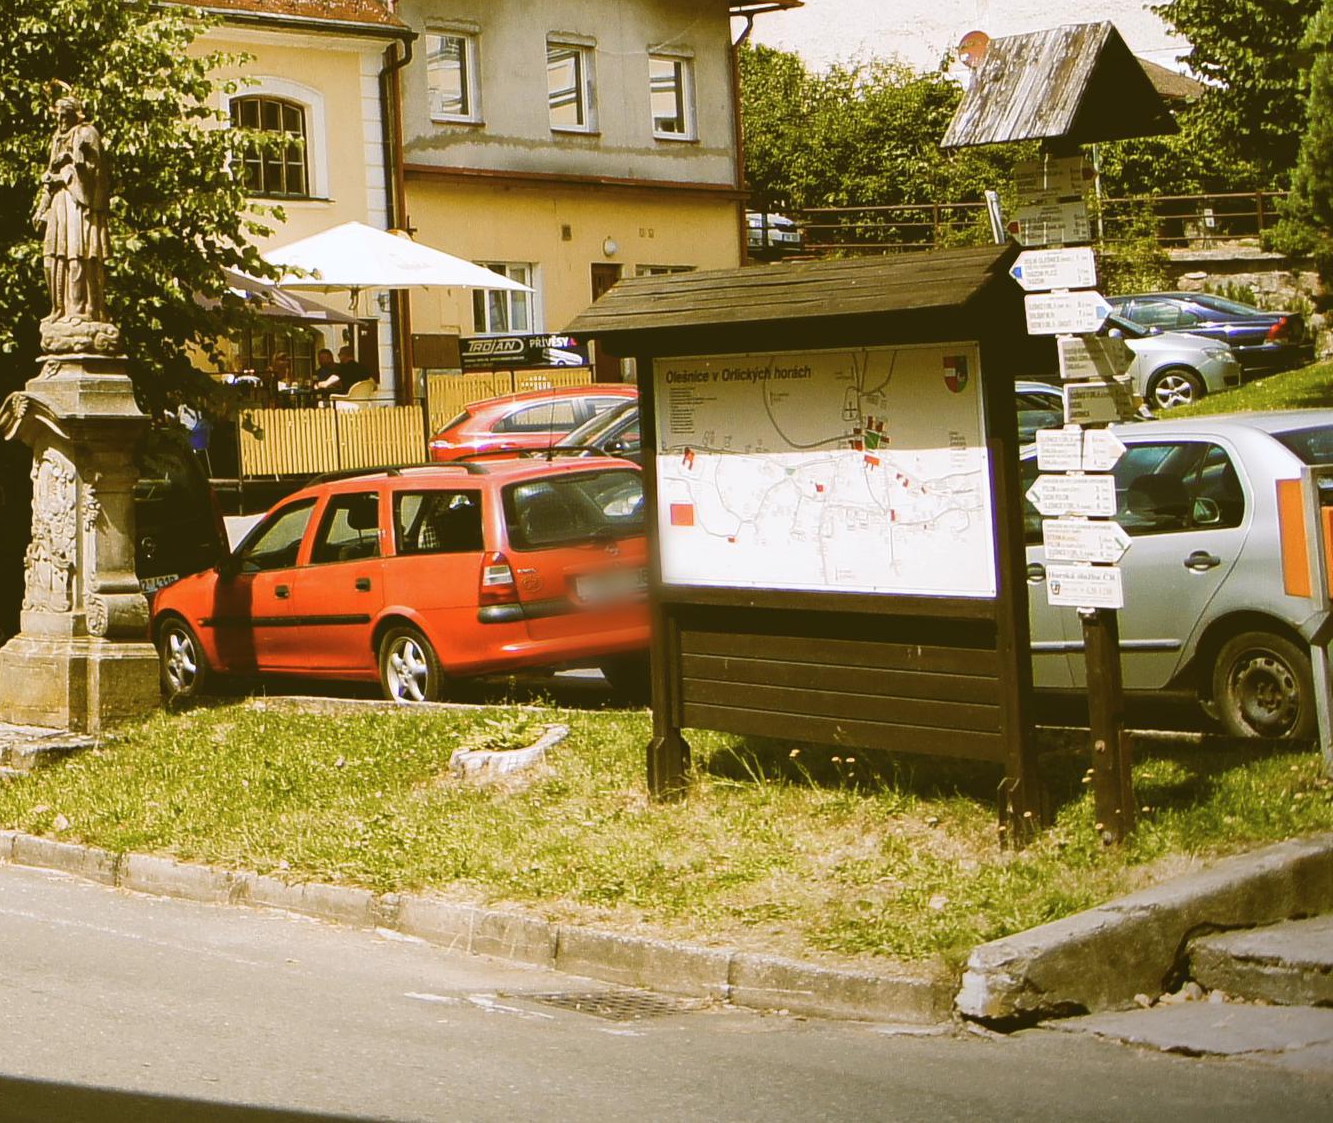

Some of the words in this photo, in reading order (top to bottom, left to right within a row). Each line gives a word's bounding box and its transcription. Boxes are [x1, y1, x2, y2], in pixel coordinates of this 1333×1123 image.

[468, 339, 516, 353] TROJAN
[529, 336, 569, 348] PŘÍVĚSY
[666, 369, 709, 383] Olešnice
[712, 372, 718, 381] v
[721, 367, 772, 383] Orlických
[774, 365, 812, 379] horách
